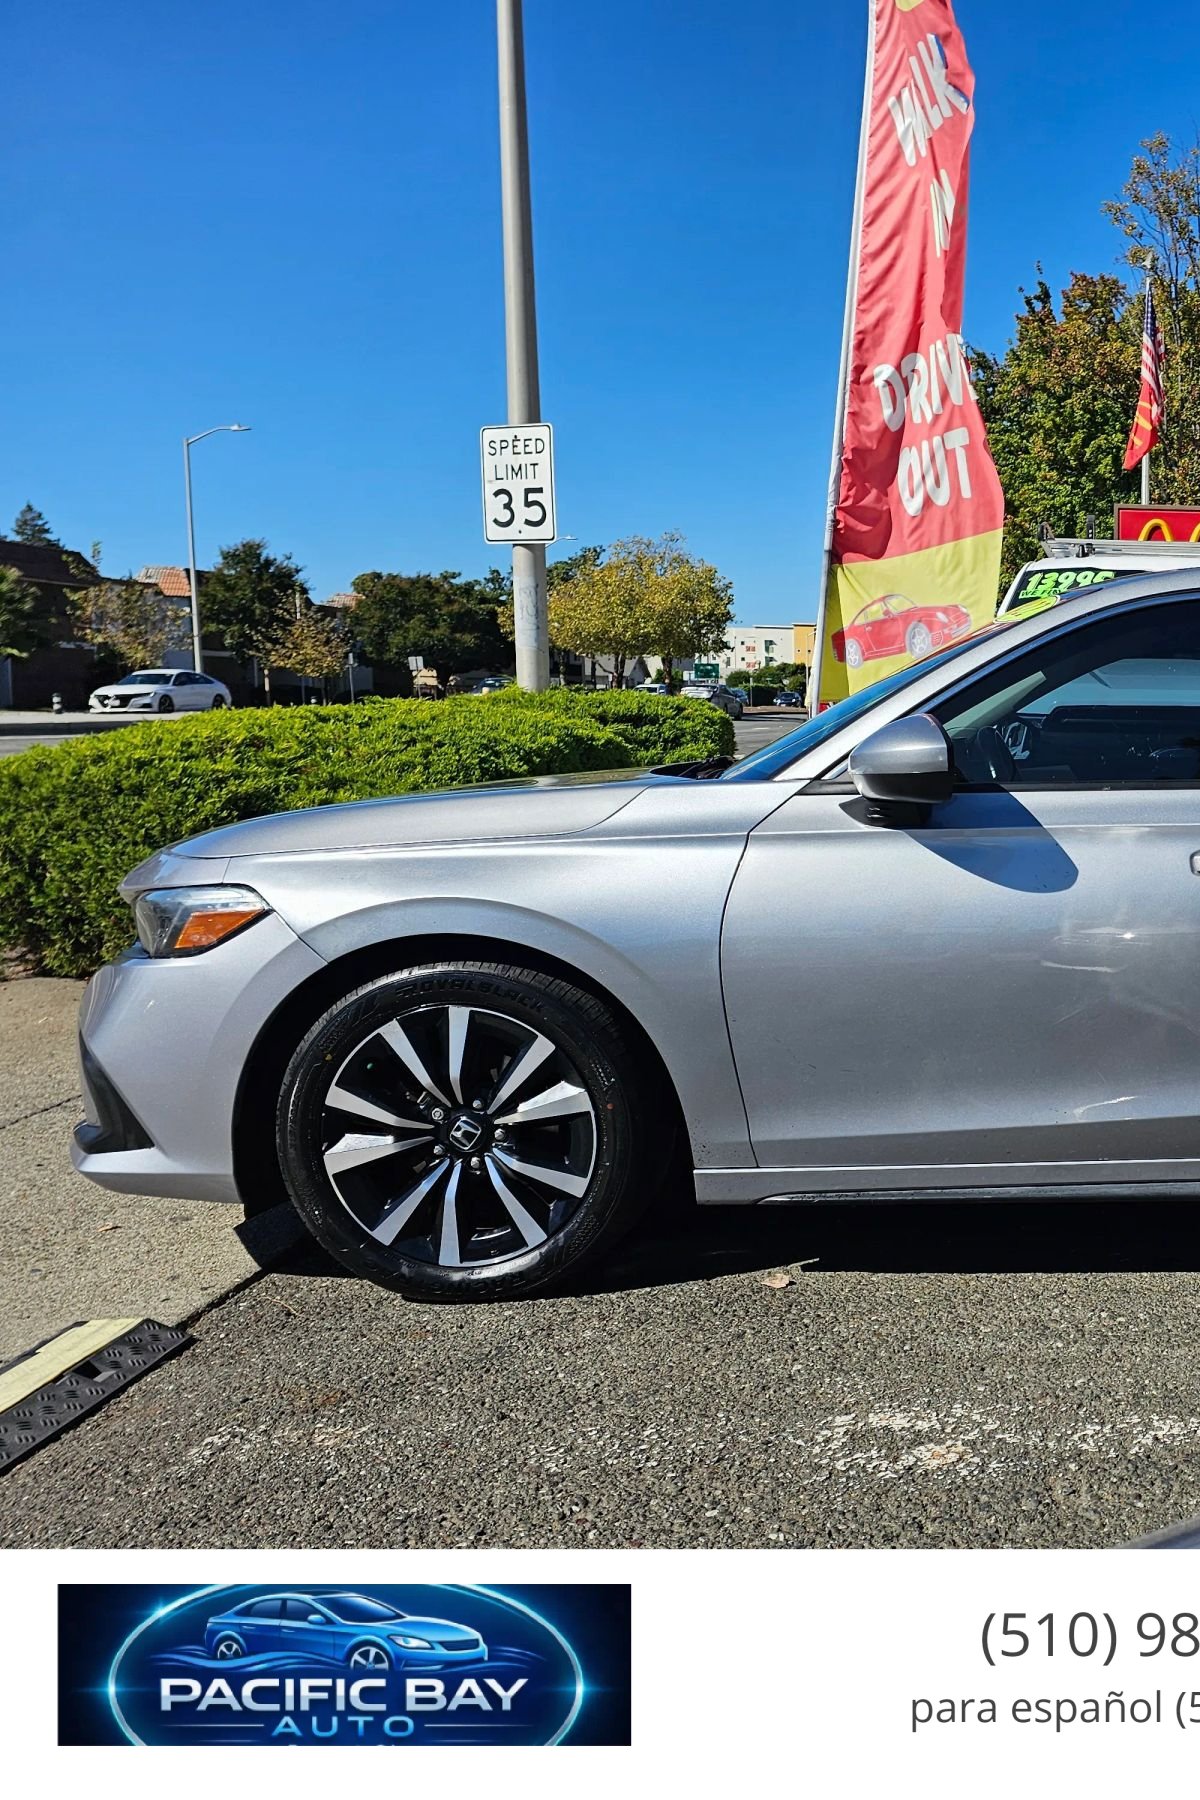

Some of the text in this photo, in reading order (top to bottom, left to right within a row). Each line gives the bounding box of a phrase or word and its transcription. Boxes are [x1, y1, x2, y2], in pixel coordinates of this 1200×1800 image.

[488, 438, 545, 456] SPEED
[494, 462, 539, 480] LIMIT
[897, 427, 971, 517] OUT
[492, 486, 547, 528] 35
